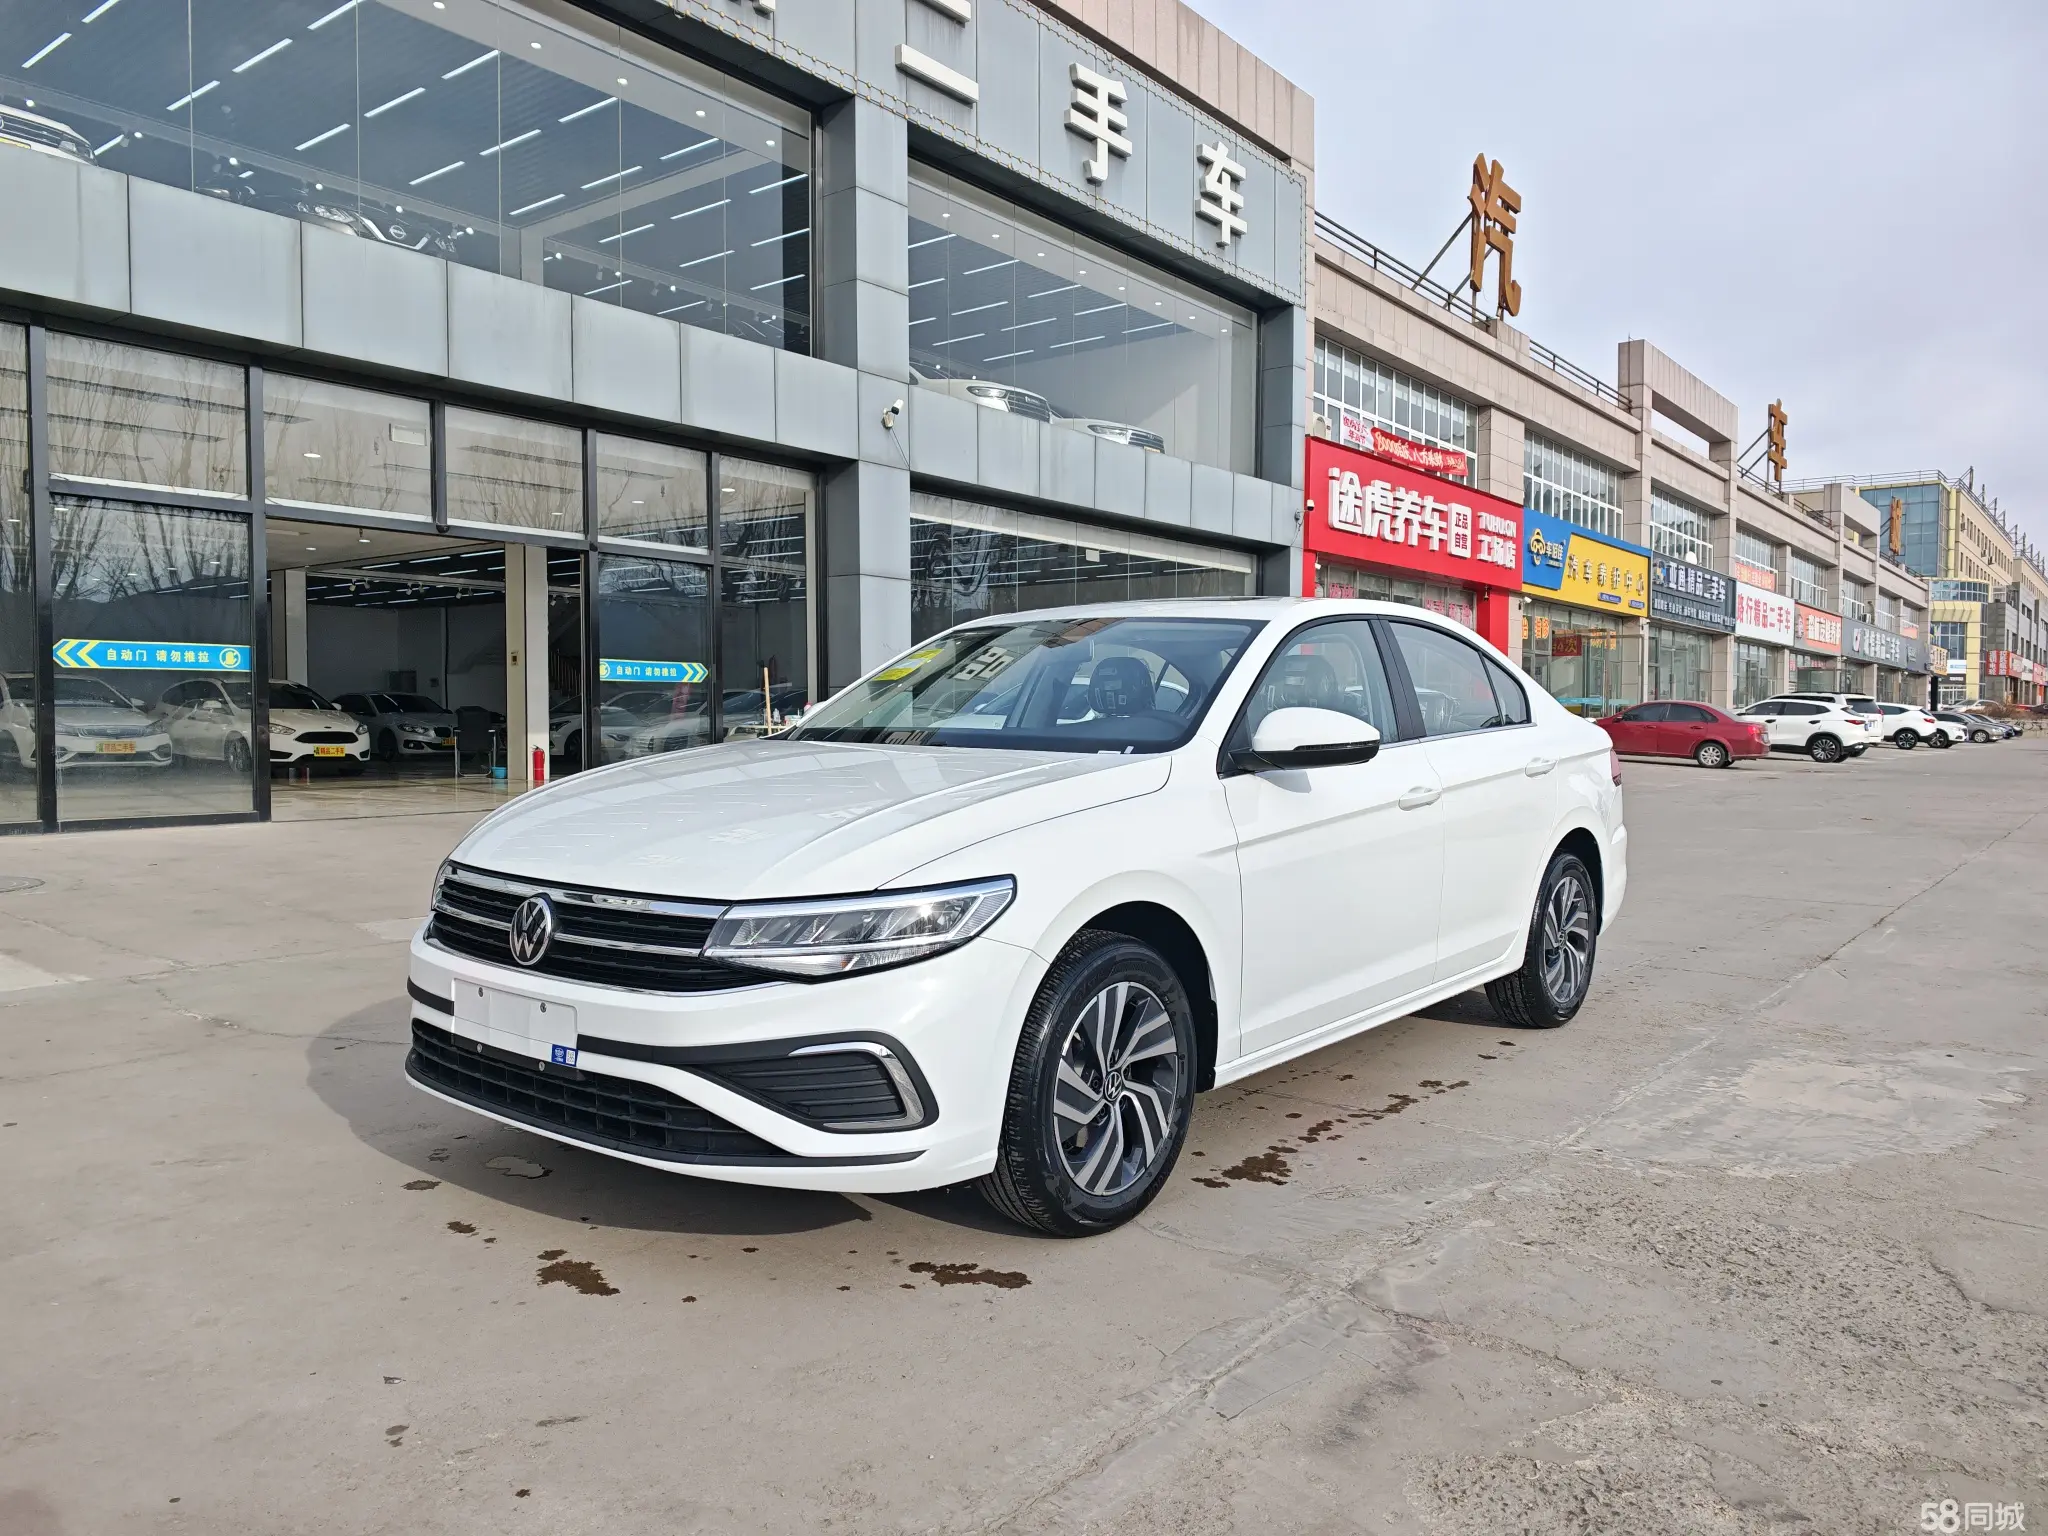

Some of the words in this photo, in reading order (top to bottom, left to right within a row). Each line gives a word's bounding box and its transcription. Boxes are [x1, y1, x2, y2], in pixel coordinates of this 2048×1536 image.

[1328, 467, 1448, 550] 途虎养车
[1455, 512, 1468, 530] 正品
[1455, 532, 1468, 550] 自营
[1477, 534, 1516, 569] 工场店
[1567, 554, 1645, 596] 汽车养护中心
[1669, 561, 1726, 603] 亚通精品二手车
[106, 649, 147, 662] 自动门
[156, 649, 210, 663] 请勿推拉
[616, 665, 640, 676] 自动门
[645, 666, 677, 677] 请勿推拉
